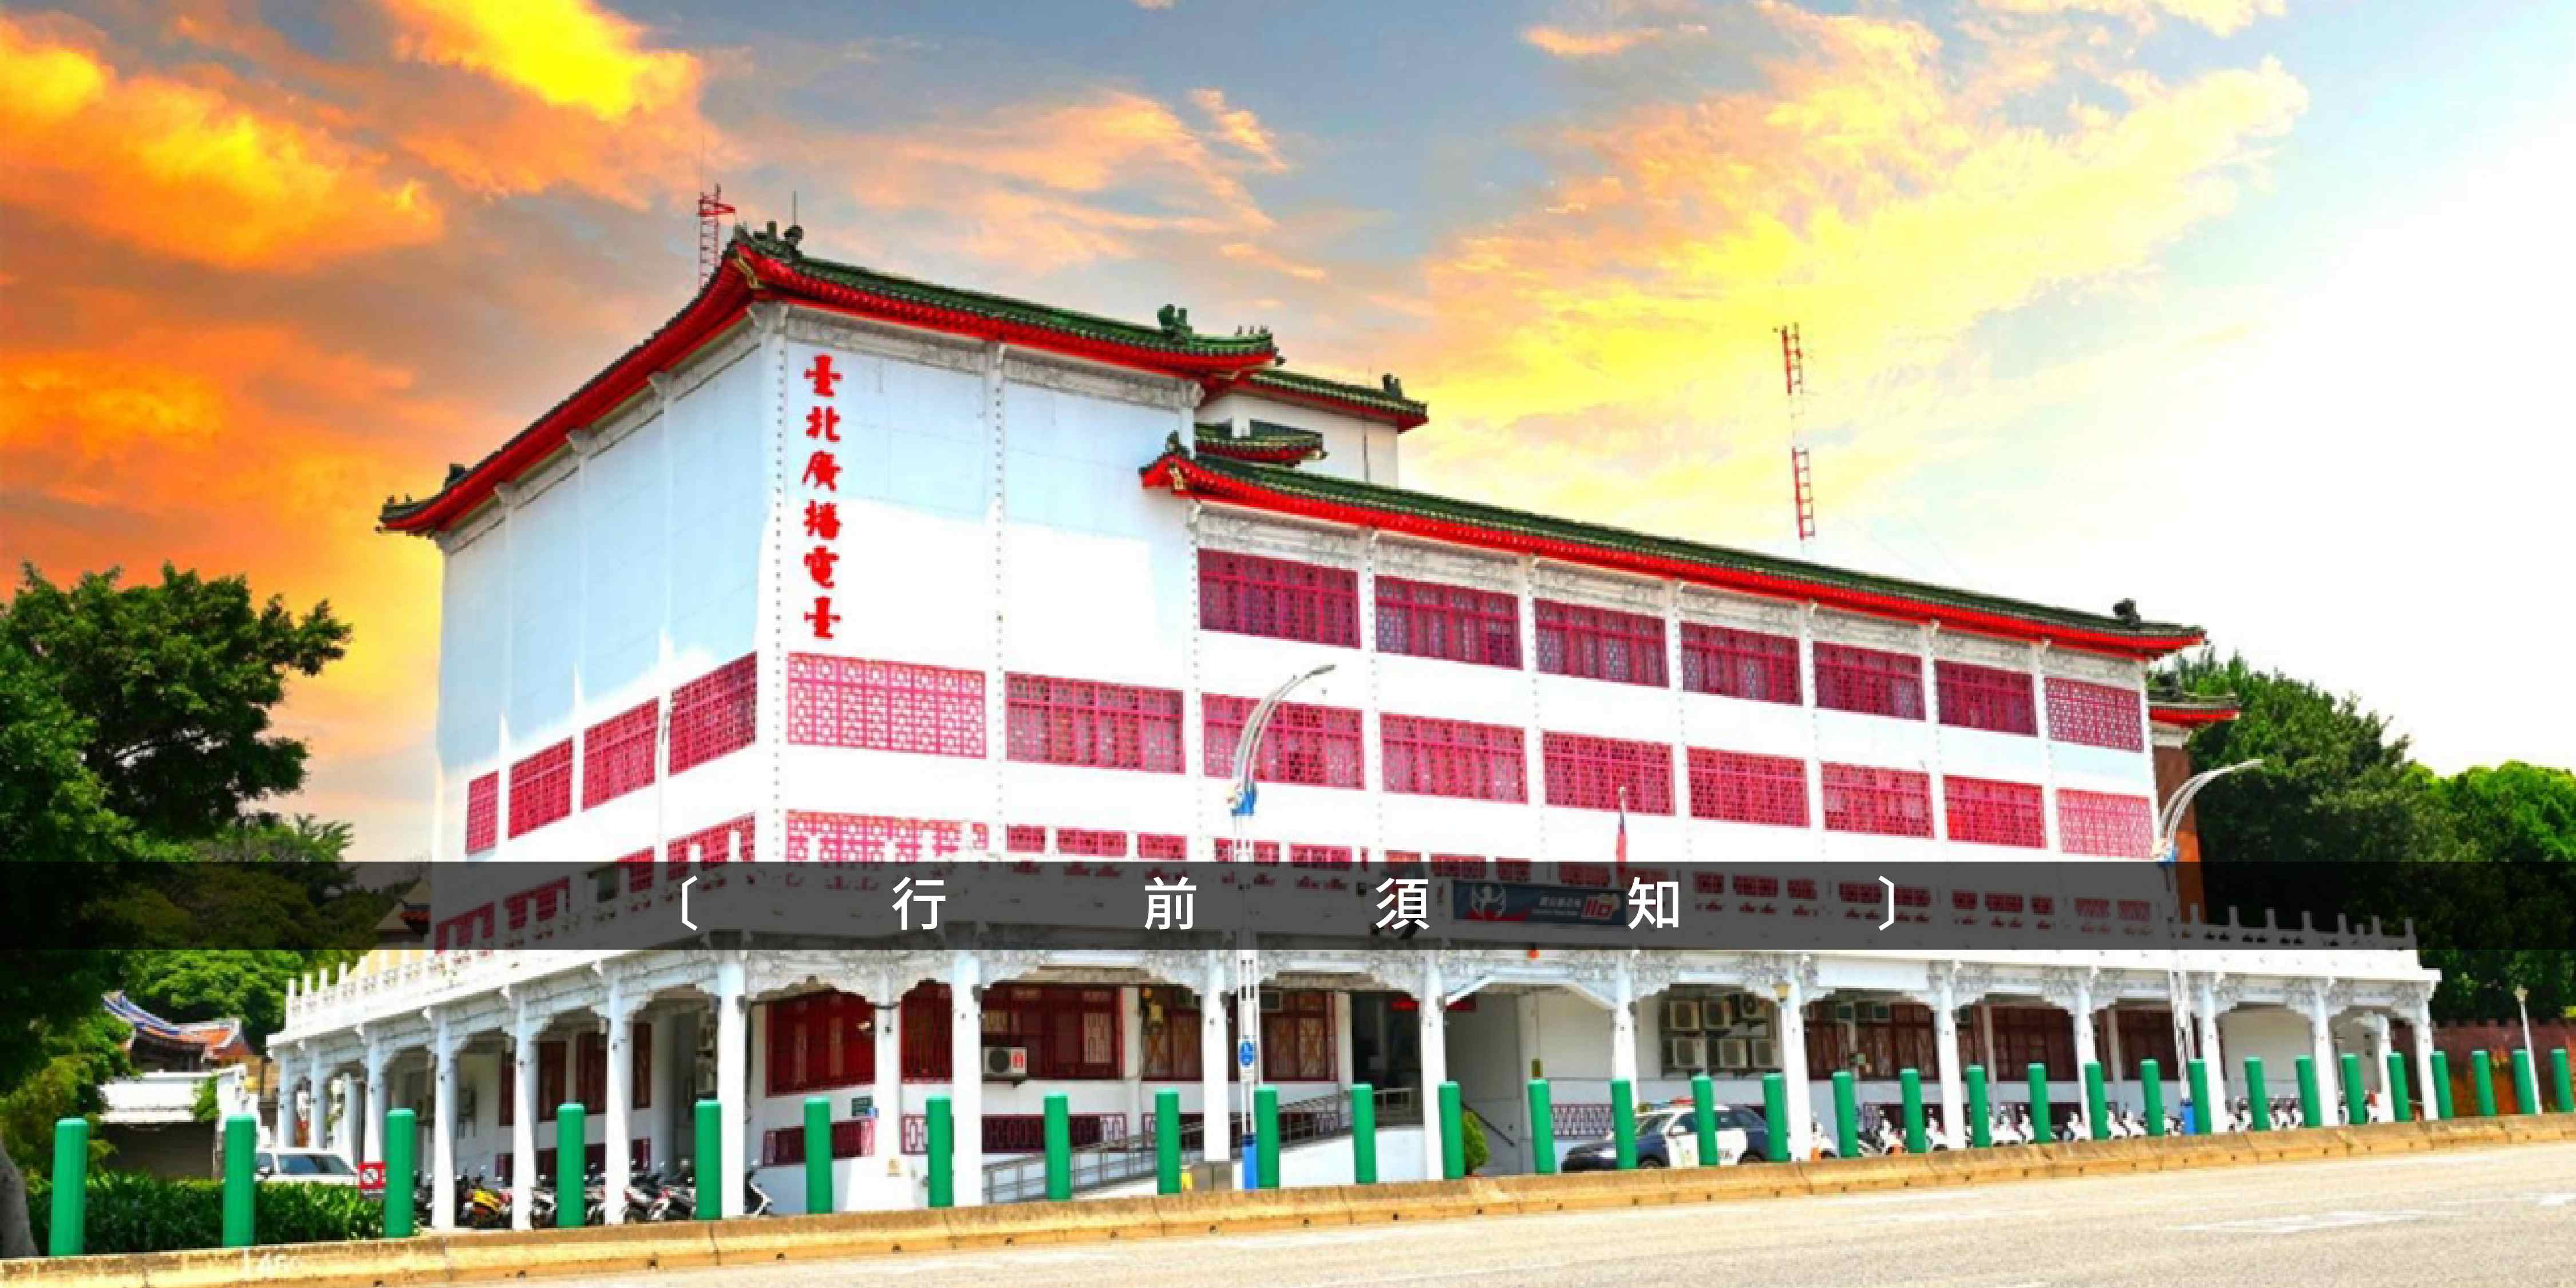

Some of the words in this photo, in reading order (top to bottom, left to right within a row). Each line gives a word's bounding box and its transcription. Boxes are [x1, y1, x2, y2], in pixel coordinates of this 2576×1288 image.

[803, 353, 842, 641] 臺北廣播電臺
